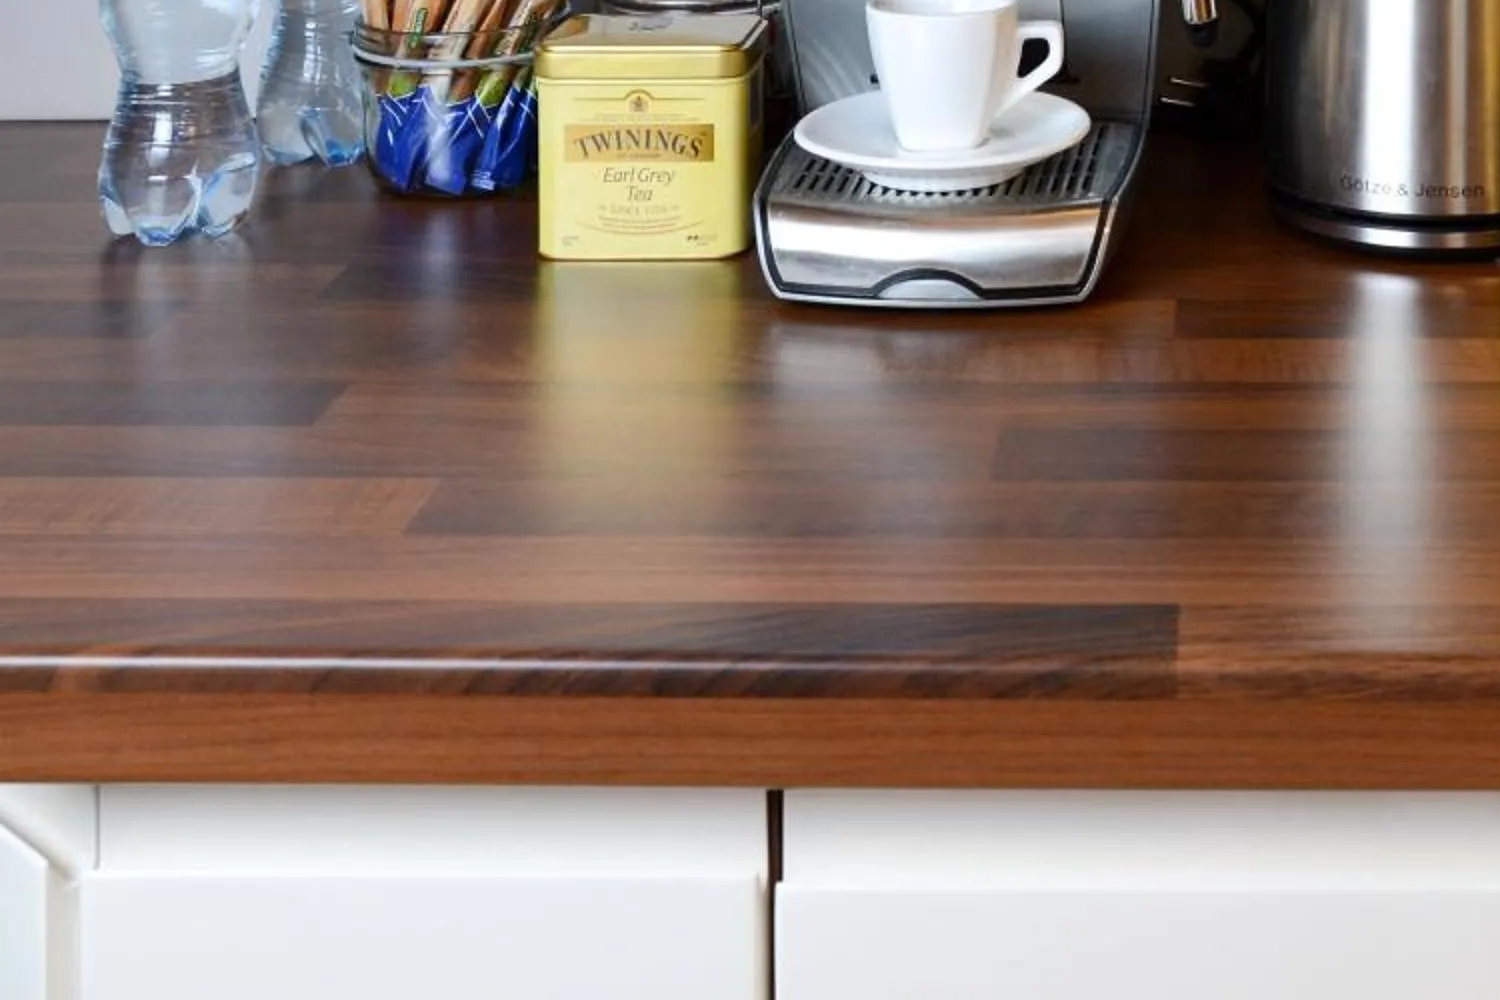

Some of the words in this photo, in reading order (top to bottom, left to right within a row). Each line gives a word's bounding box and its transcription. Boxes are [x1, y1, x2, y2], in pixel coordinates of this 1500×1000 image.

[573, 128, 703, 158] TWININGS
[603, 167, 635, 183] Earl
[637, 167, 675, 186] Grey
[626, 185, 653, 201] Tea
[1397, 183, 1409, 197] &
[1415, 182, 1485, 198] Jensen
